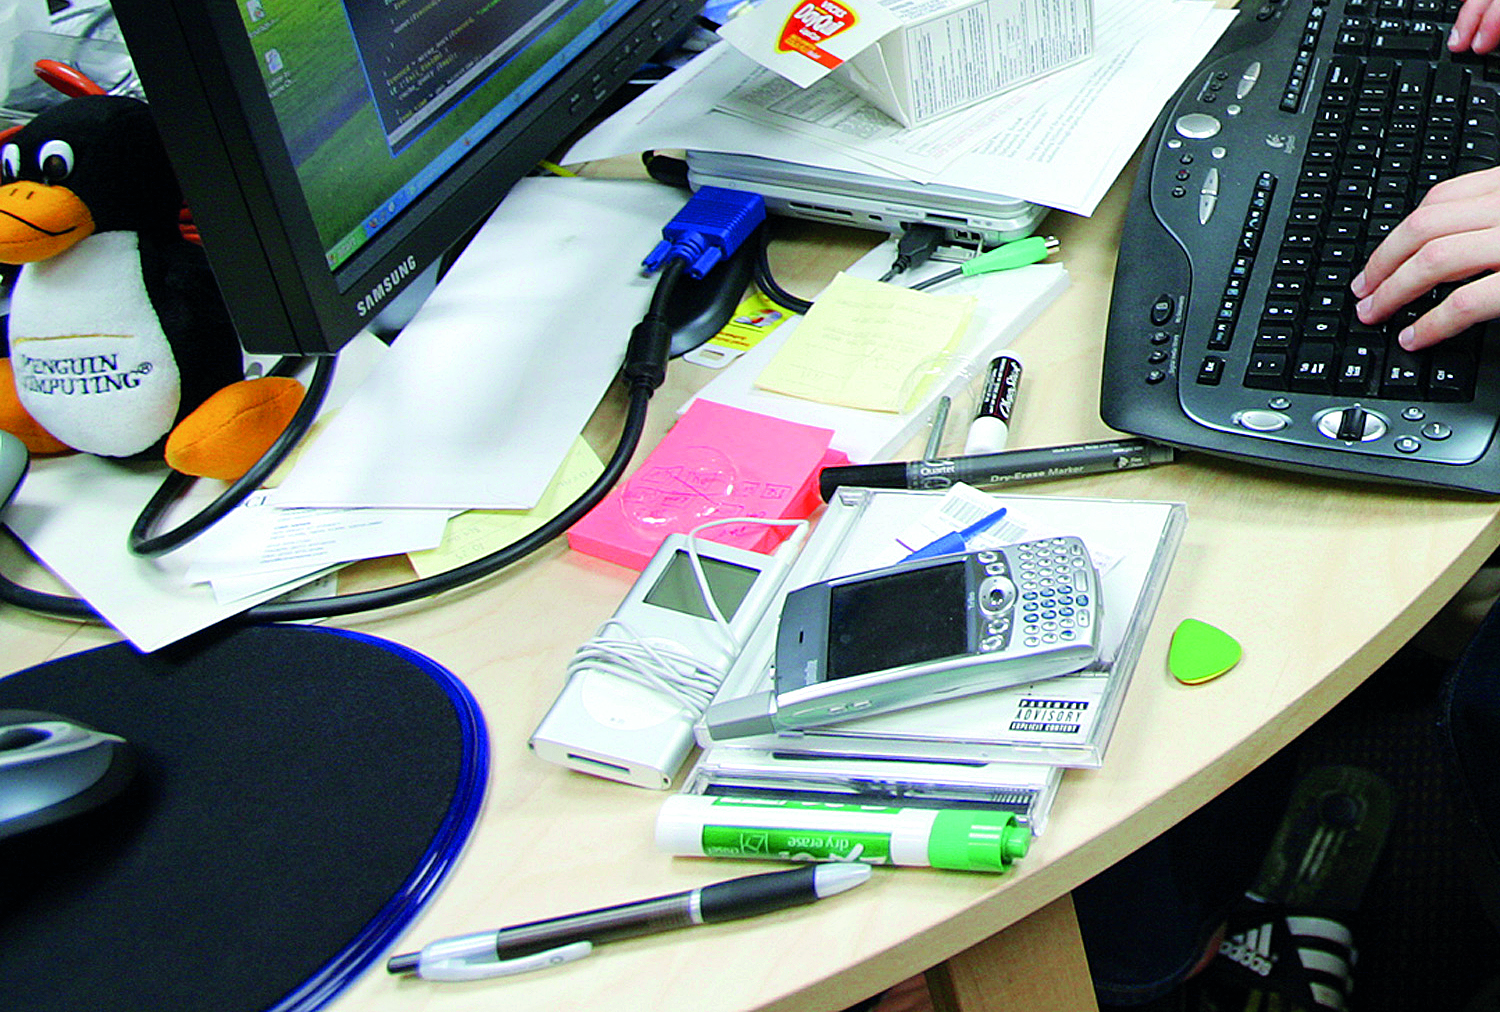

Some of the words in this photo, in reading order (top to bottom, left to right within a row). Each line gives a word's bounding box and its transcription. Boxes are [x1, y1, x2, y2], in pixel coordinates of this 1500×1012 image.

[793, 3, 846, 36] DayQuil
[357, 255, 417, 317] SAMSUNG
[990, 470, 1045, 484] Dry-Erase
[1047, 464, 1085, 478] Marker
[1015, 708, 1083, 722] ADVISORY
[787, 836, 822, 848] erase
[825, 836, 850, 851] dry
